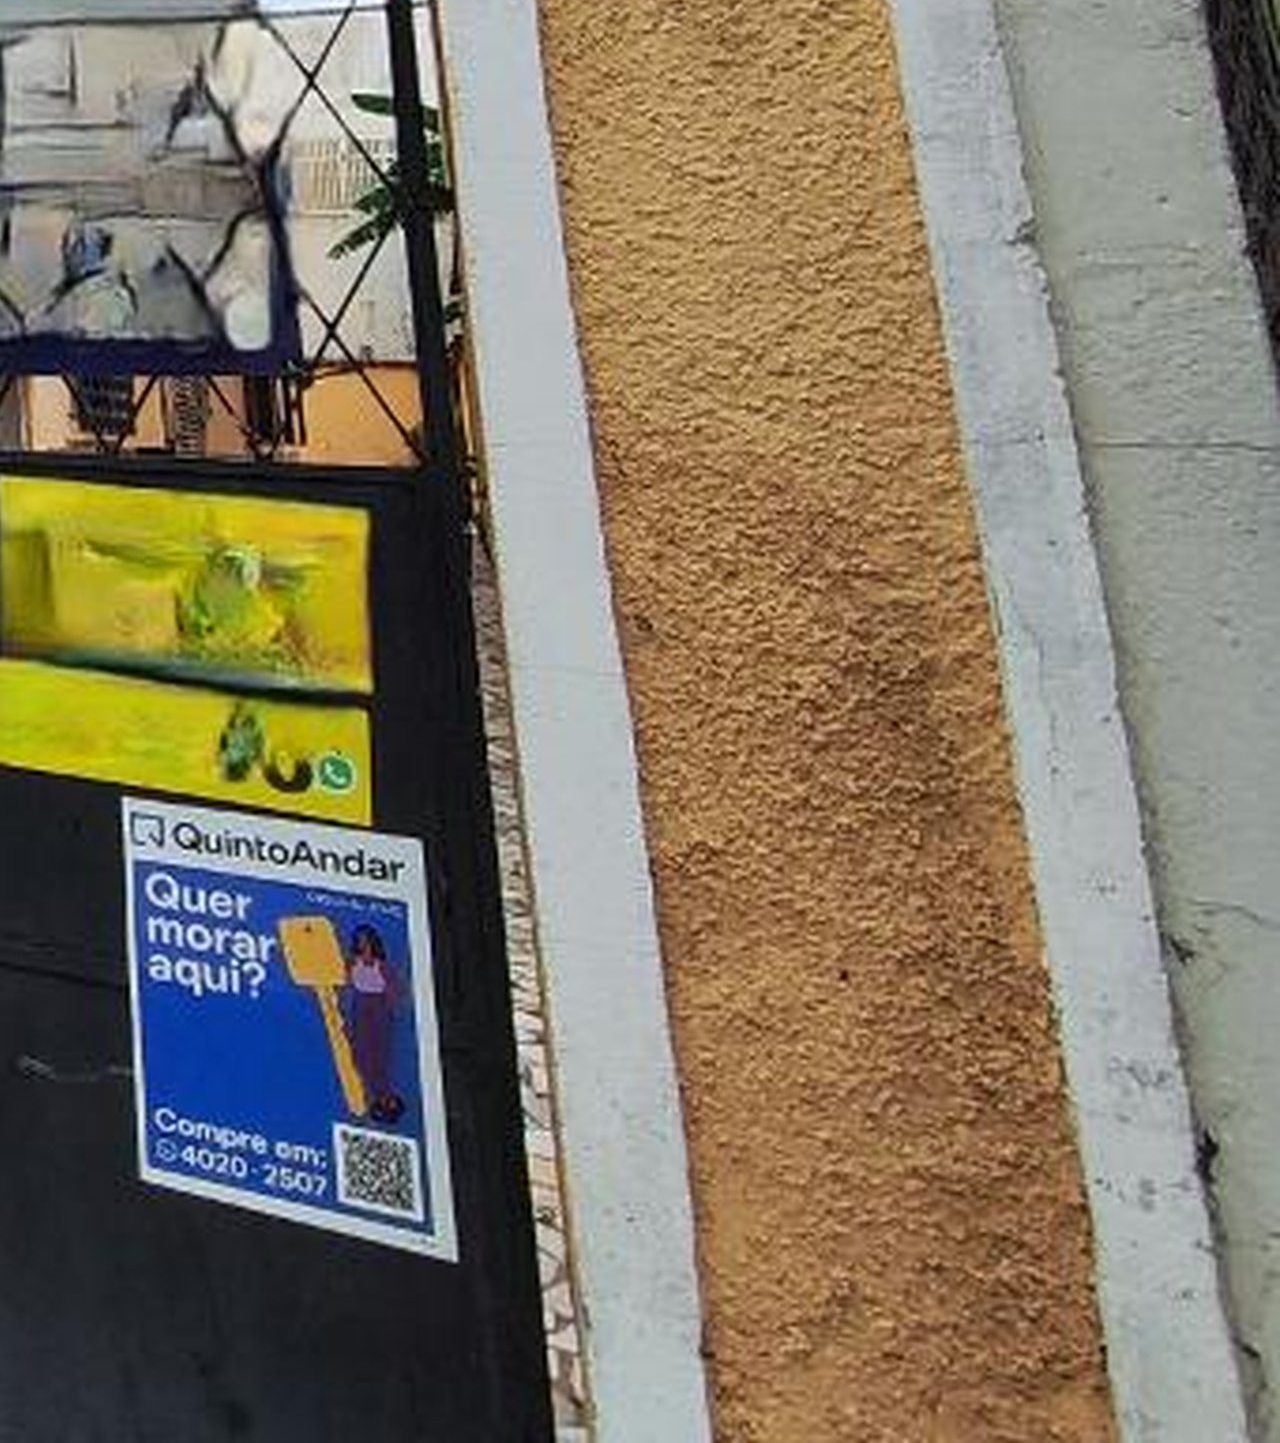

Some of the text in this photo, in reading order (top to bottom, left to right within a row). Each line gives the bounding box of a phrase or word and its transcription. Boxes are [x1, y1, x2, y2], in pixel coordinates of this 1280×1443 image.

[172, 822, 404, 883] QuintoAndar
[145, 872, 252, 919] Quer
[147, 915, 276, 962] morar
[148, 953, 266, 998] aqui?
[154, 1108, 267, 1155] Compre
